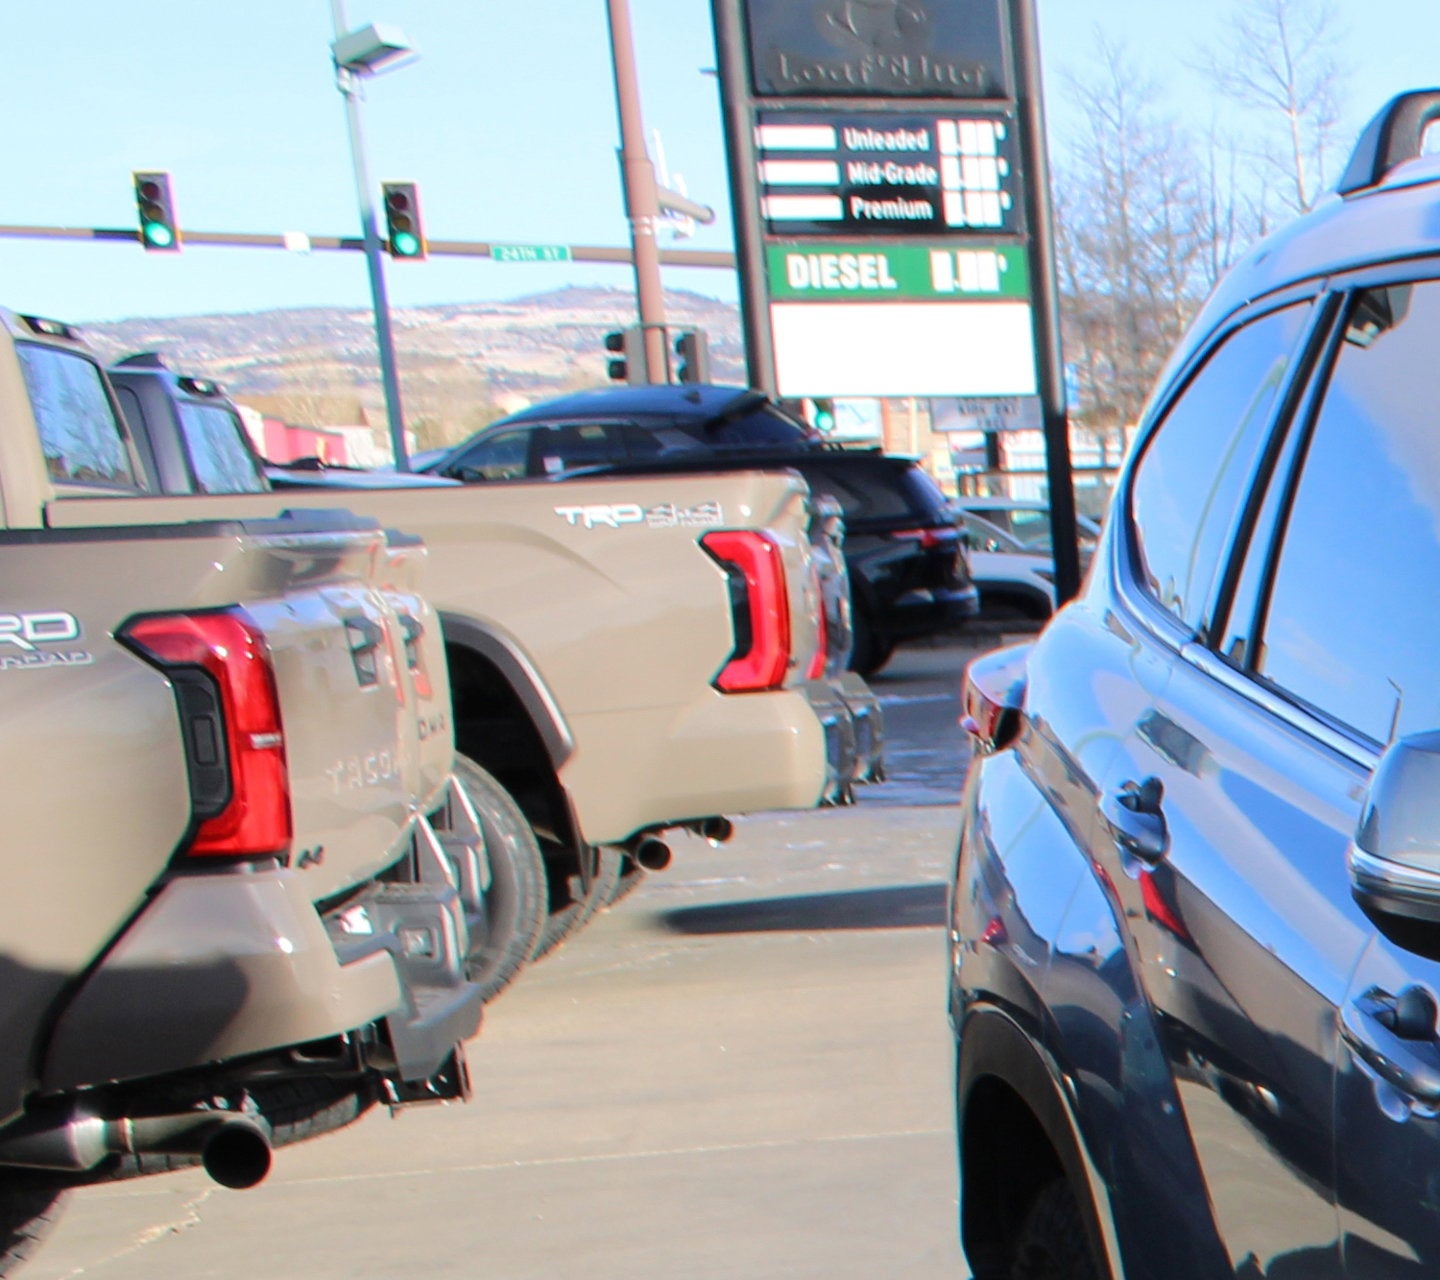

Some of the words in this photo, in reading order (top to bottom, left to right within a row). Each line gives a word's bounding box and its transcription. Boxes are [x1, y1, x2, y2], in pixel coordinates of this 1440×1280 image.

[843, 127, 930, 151] Unleaded
[847, 161, 939, 186] Mid-Grade
[850, 195, 934, 220] Premium
[785, 253, 898, 289] DIESEL
[553, 503, 644, 529] TRD
